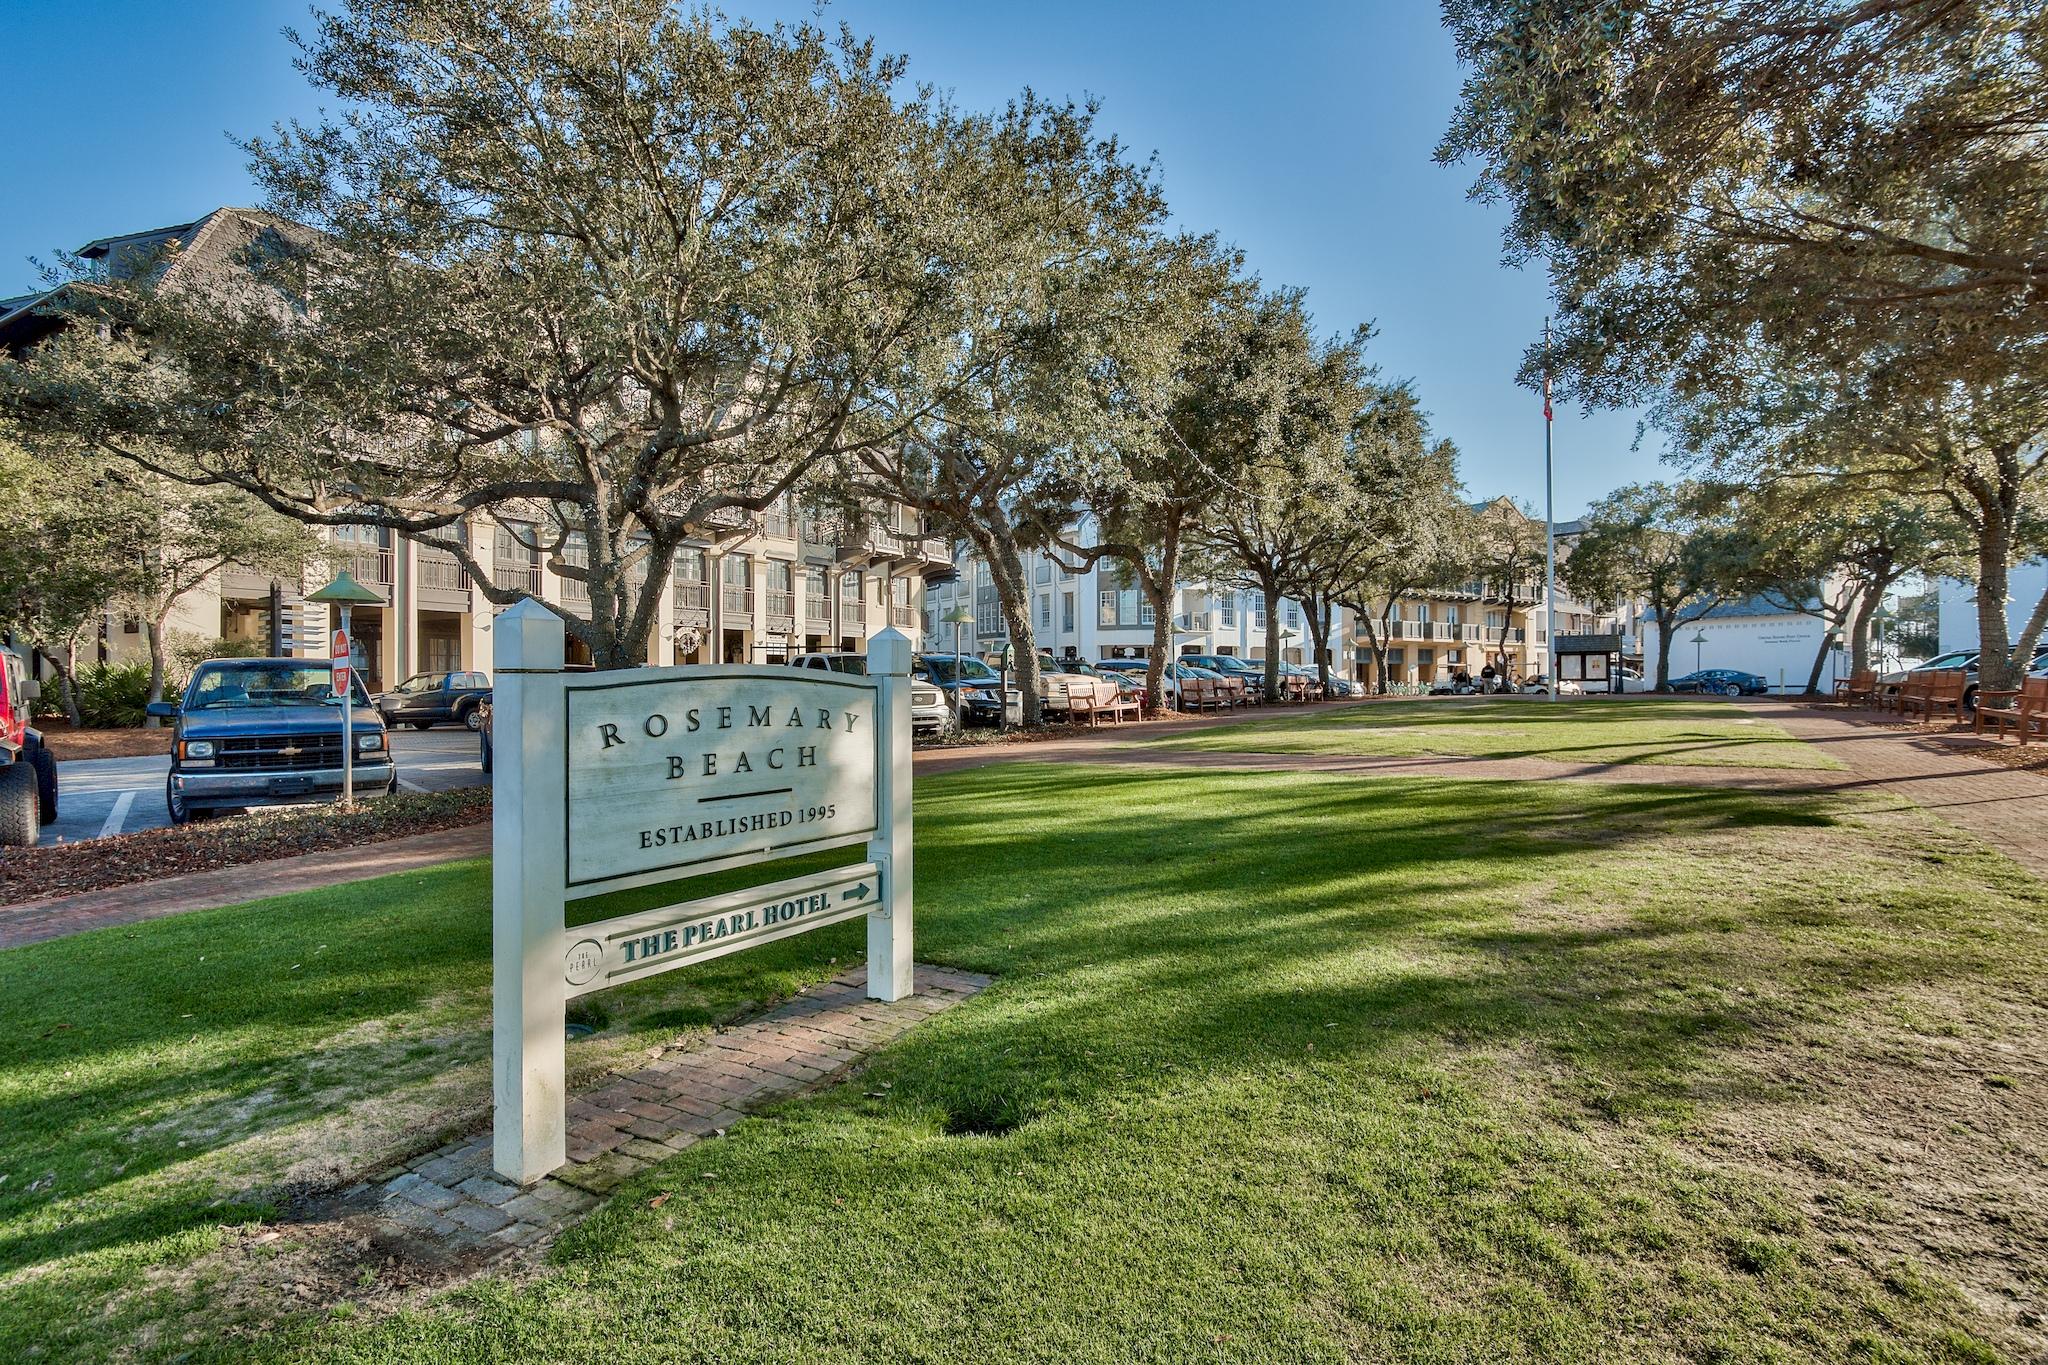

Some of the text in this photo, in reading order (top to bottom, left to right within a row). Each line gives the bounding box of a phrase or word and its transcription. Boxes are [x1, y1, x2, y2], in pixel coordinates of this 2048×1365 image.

[336, 672, 346, 682] ENTER
[598, 705, 860, 749] ROSEMARY
[666, 745, 817, 781] BEACH
[639, 804, 836, 850] ESTABLISHED 1995
[619, 892, 831, 964] THE PEARL HOTEL
[569, 957, 600, 972] PEARL
